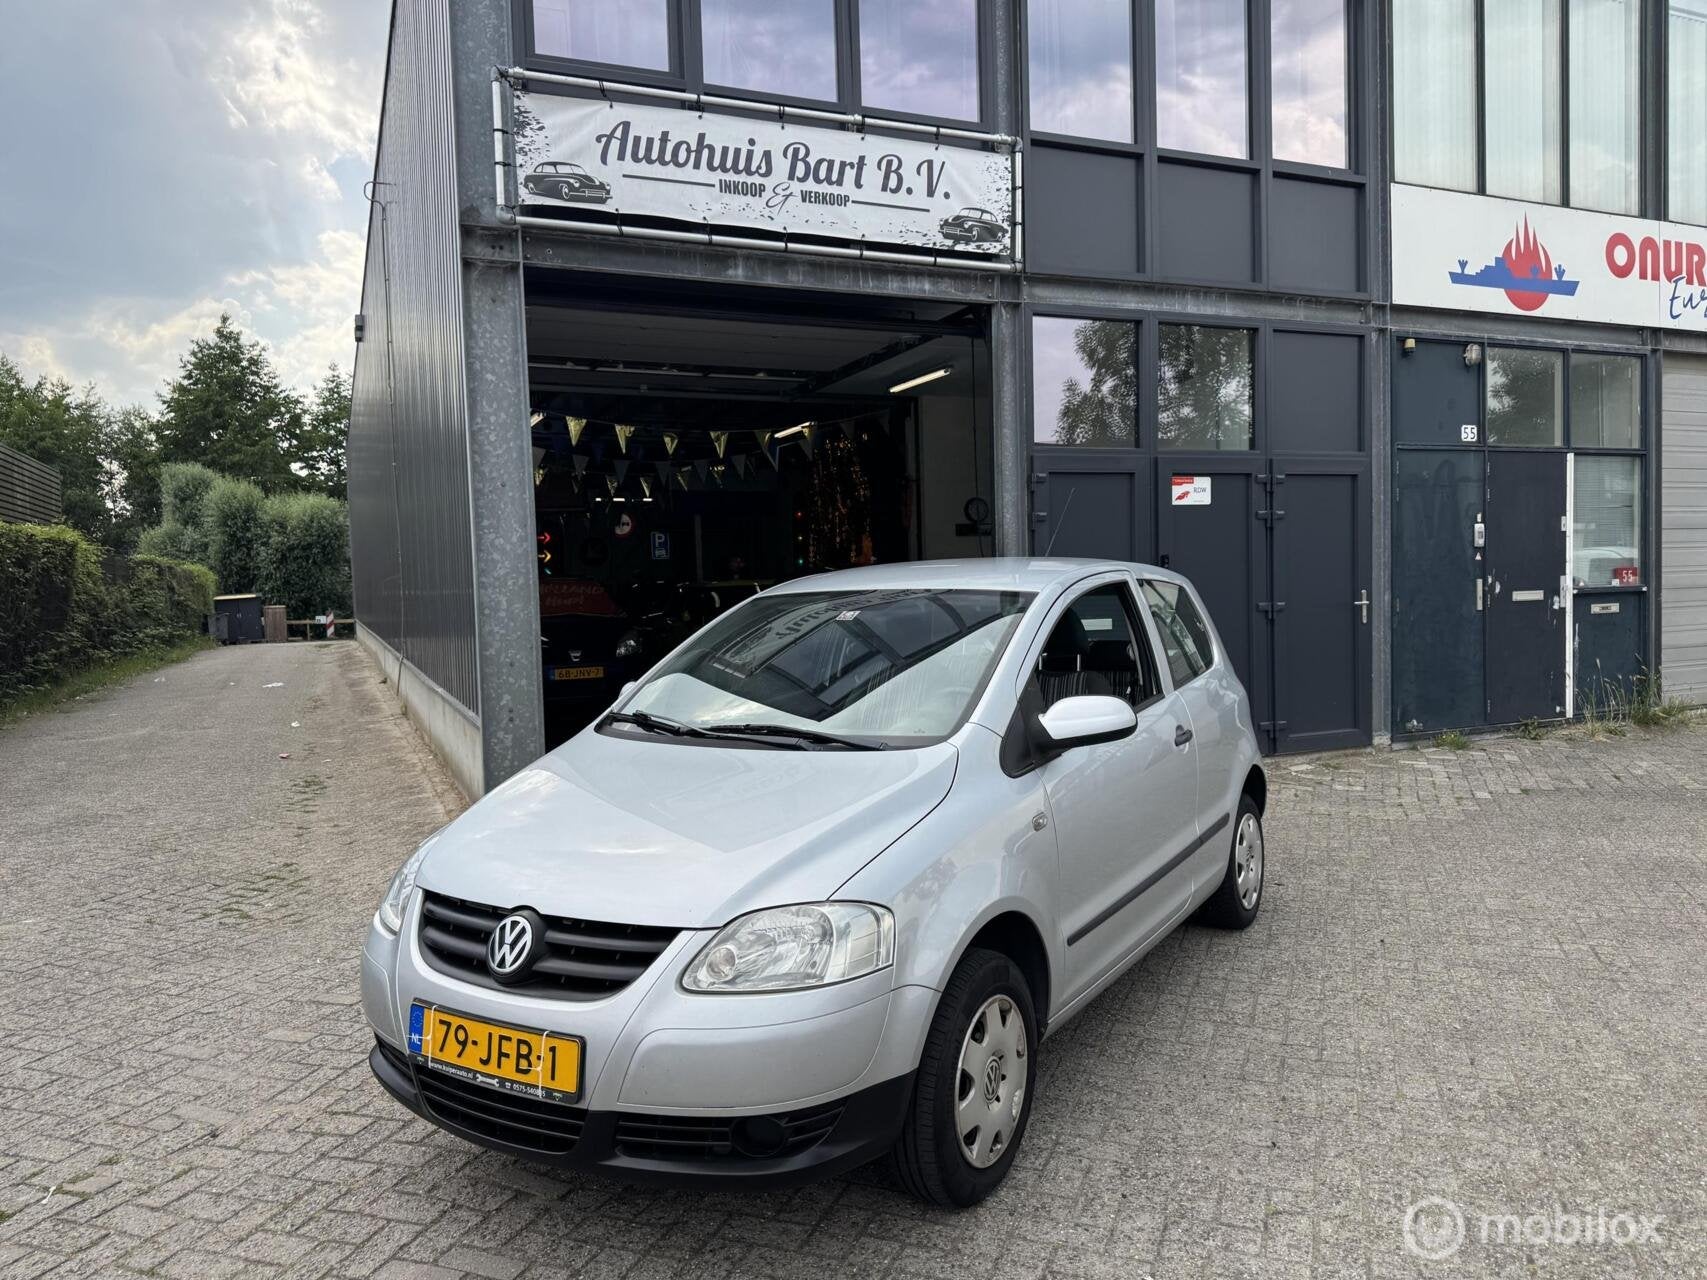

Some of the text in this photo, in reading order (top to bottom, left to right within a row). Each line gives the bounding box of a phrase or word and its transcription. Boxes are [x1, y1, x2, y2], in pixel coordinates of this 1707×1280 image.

[595, 121, 951, 200] Autohuis Bart B.V.
[719, 179, 766, 198] INKOOP
[800, 190, 850, 207] VERKOOP
[1605, 232, 1707, 287] ONUR
[1463, 426, 1476, 440] 55
[1622, 570, 1633, 582] 55
[411, 1032, 421, 1045] NL
[438, 1019, 557, 1082] 79-JFB-1
